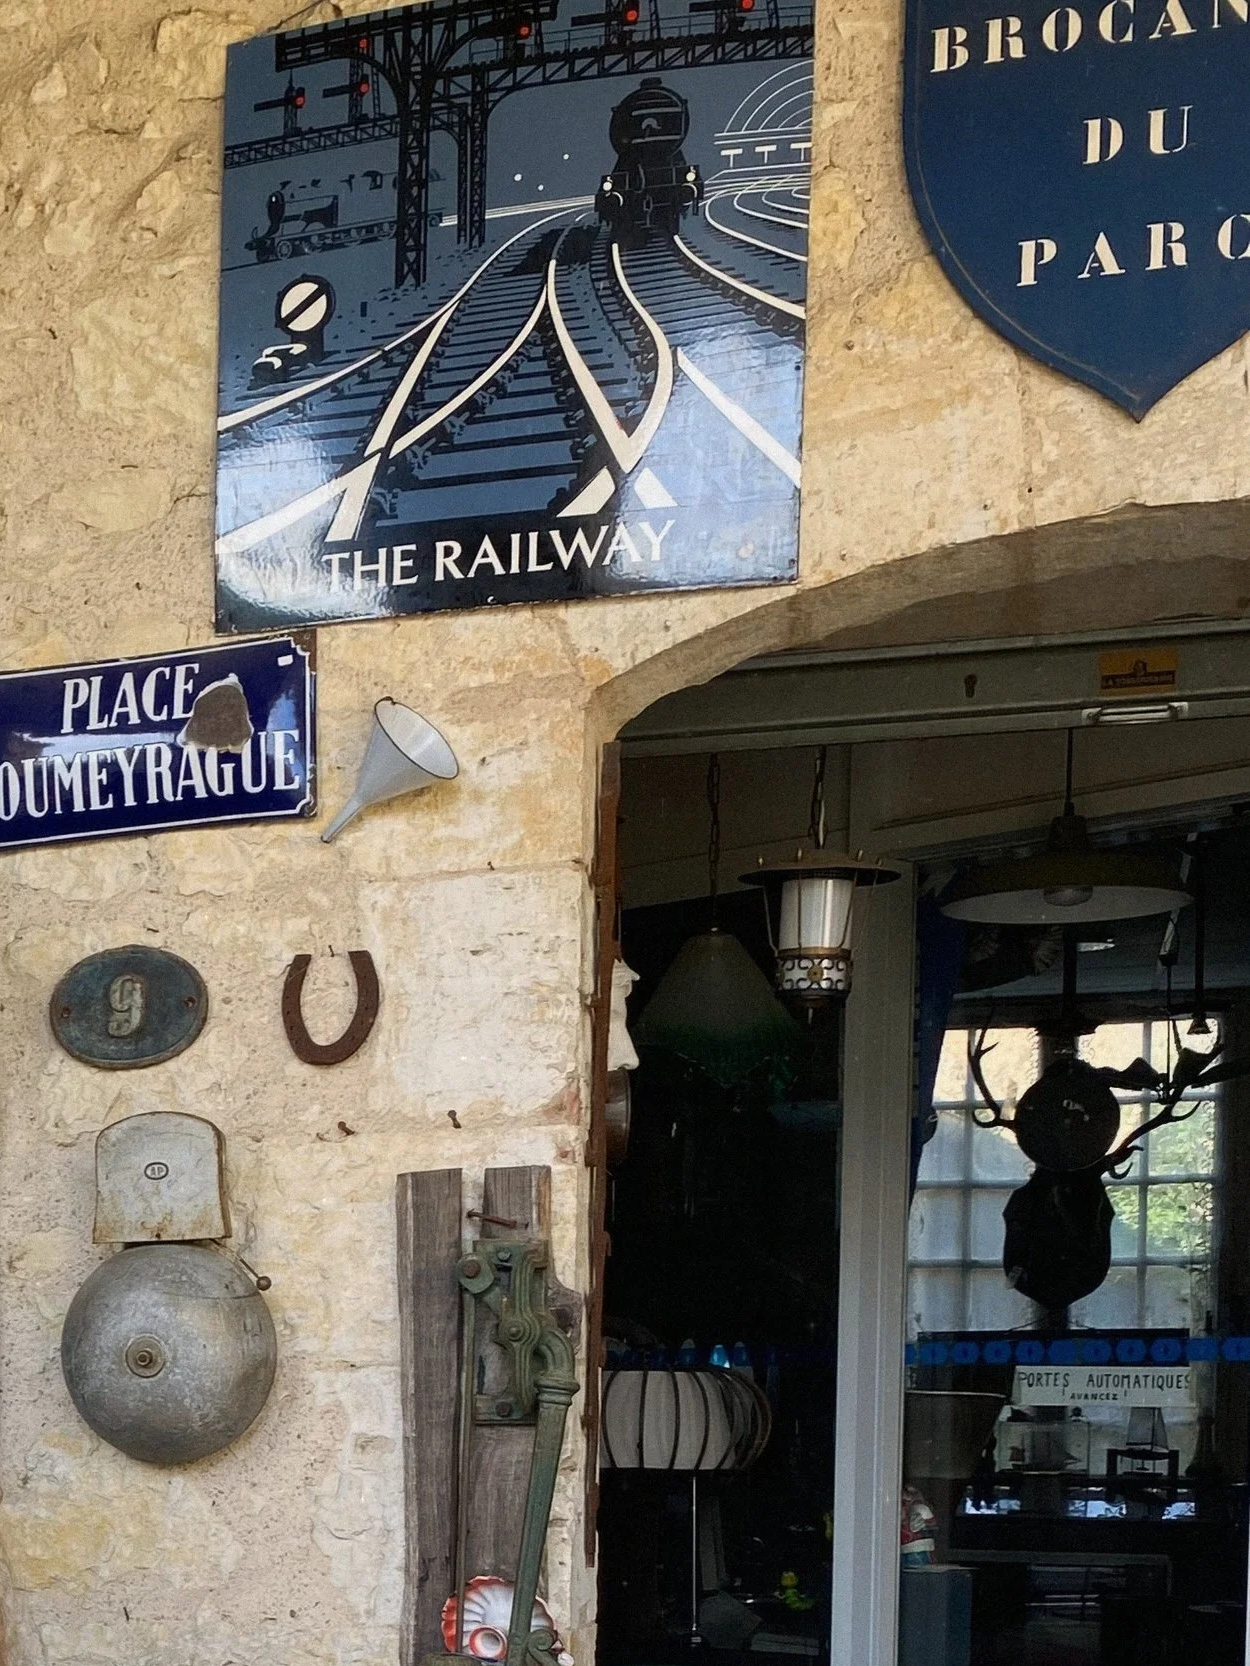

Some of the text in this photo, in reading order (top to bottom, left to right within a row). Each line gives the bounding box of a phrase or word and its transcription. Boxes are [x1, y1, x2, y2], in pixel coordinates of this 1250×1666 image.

[1083, 105, 1193, 165] DU
[1017, 213, 1250, 287] PARC
[323, 519, 677, 596] THE RAILWAY
[60, 662, 200, 735] PLACE
[107, 974, 145, 1039] 9
[1018, 1372, 1191, 1390] PORTES AUTOMATIQUES
[1070, 1392, 1119, 1401] AVANCEZ
